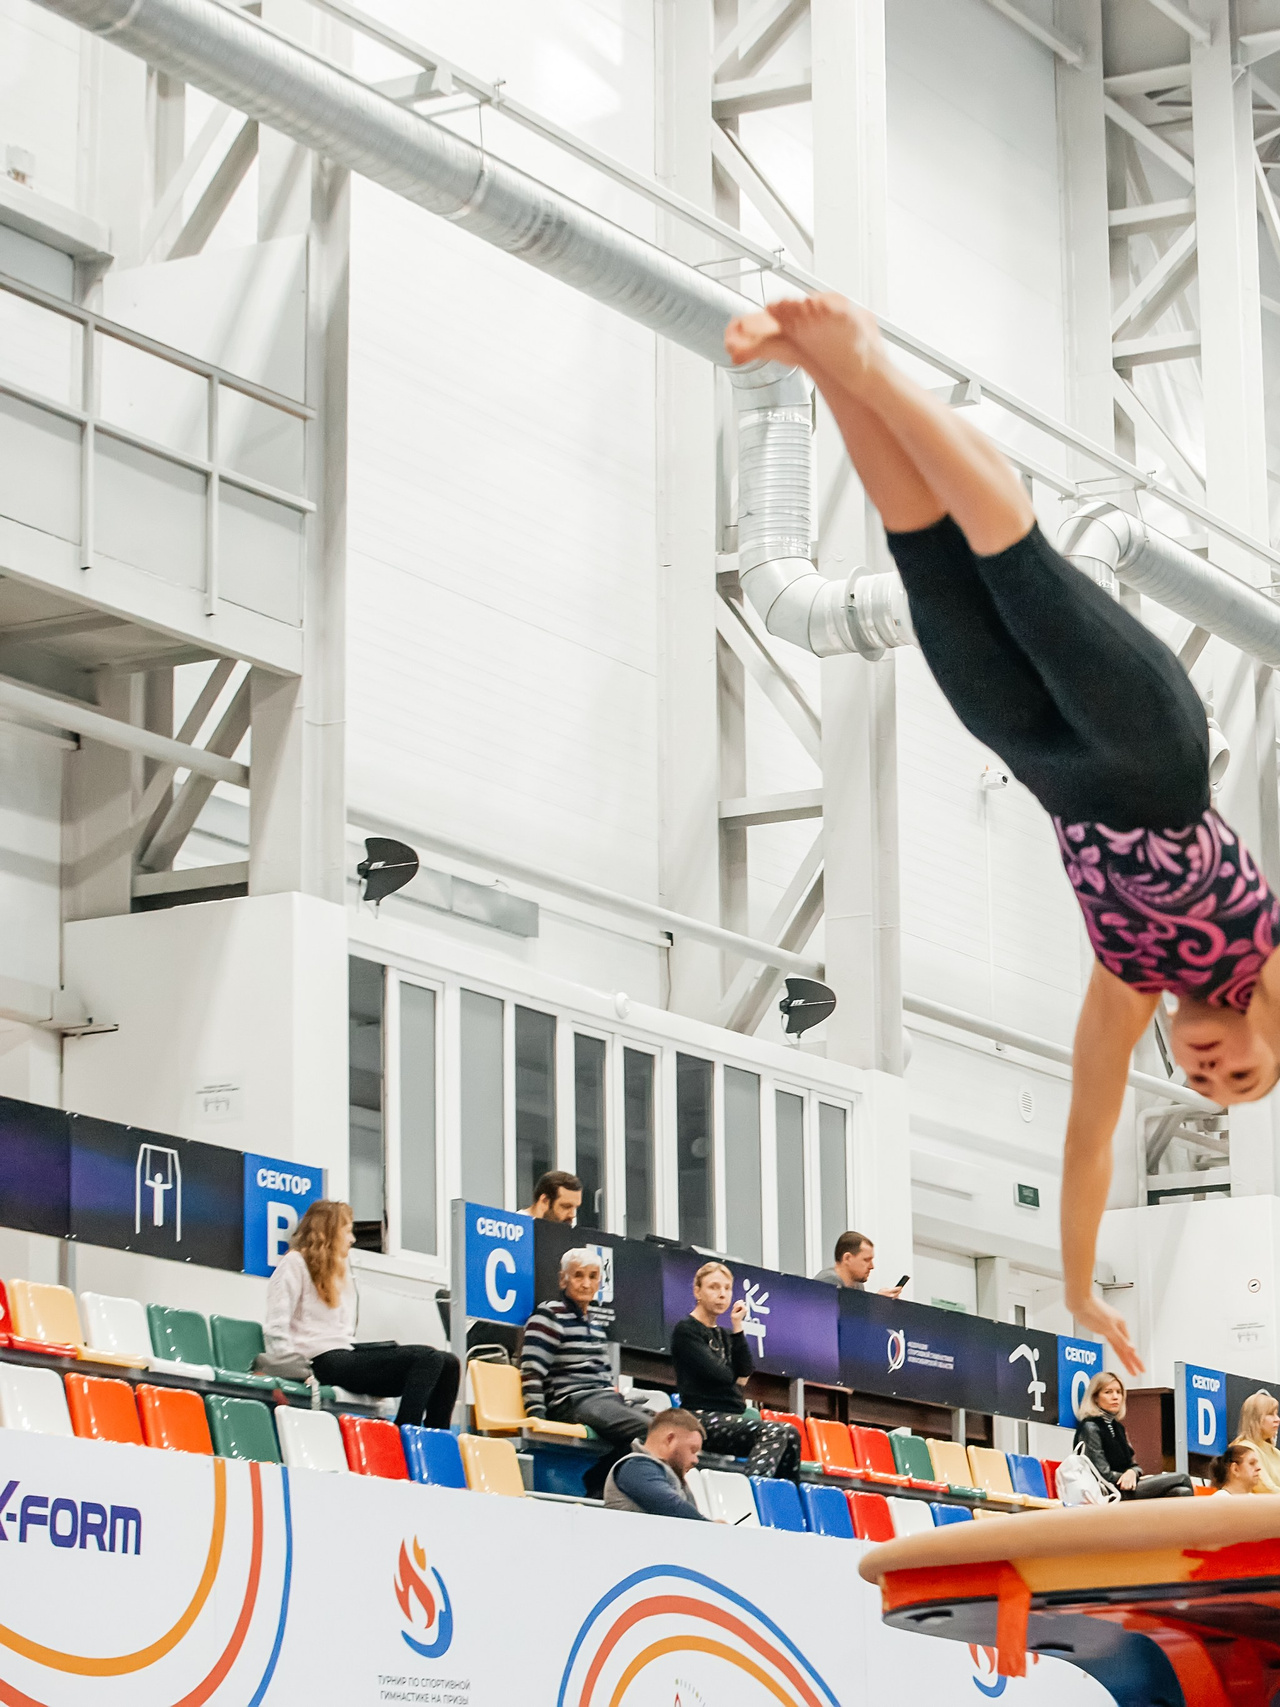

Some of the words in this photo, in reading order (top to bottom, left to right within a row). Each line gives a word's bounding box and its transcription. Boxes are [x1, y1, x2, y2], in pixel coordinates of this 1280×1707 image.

[257, 1168, 312, 1196] СЕКТОР
[476, 1217, 524, 1242] СЕКТОР
[1065, 1346, 1097, 1365] СЕКТОР
[1192, 1374, 1221, 1393] СЕКТОР
[1197, 1397, 1217, 1446] D
[378, 1674, 406, 1686] ТУРНИР
[408, 1677, 419, 1688] ПО
[421, 1678, 471, 1690] СПОРТИВНОЙ
[380, 1690, 429, 1703] ГИМНАСТИКЕ
[432, 1694, 441, 1703] НА
[443, 1694, 469, 1705] ПРИЗЫ
